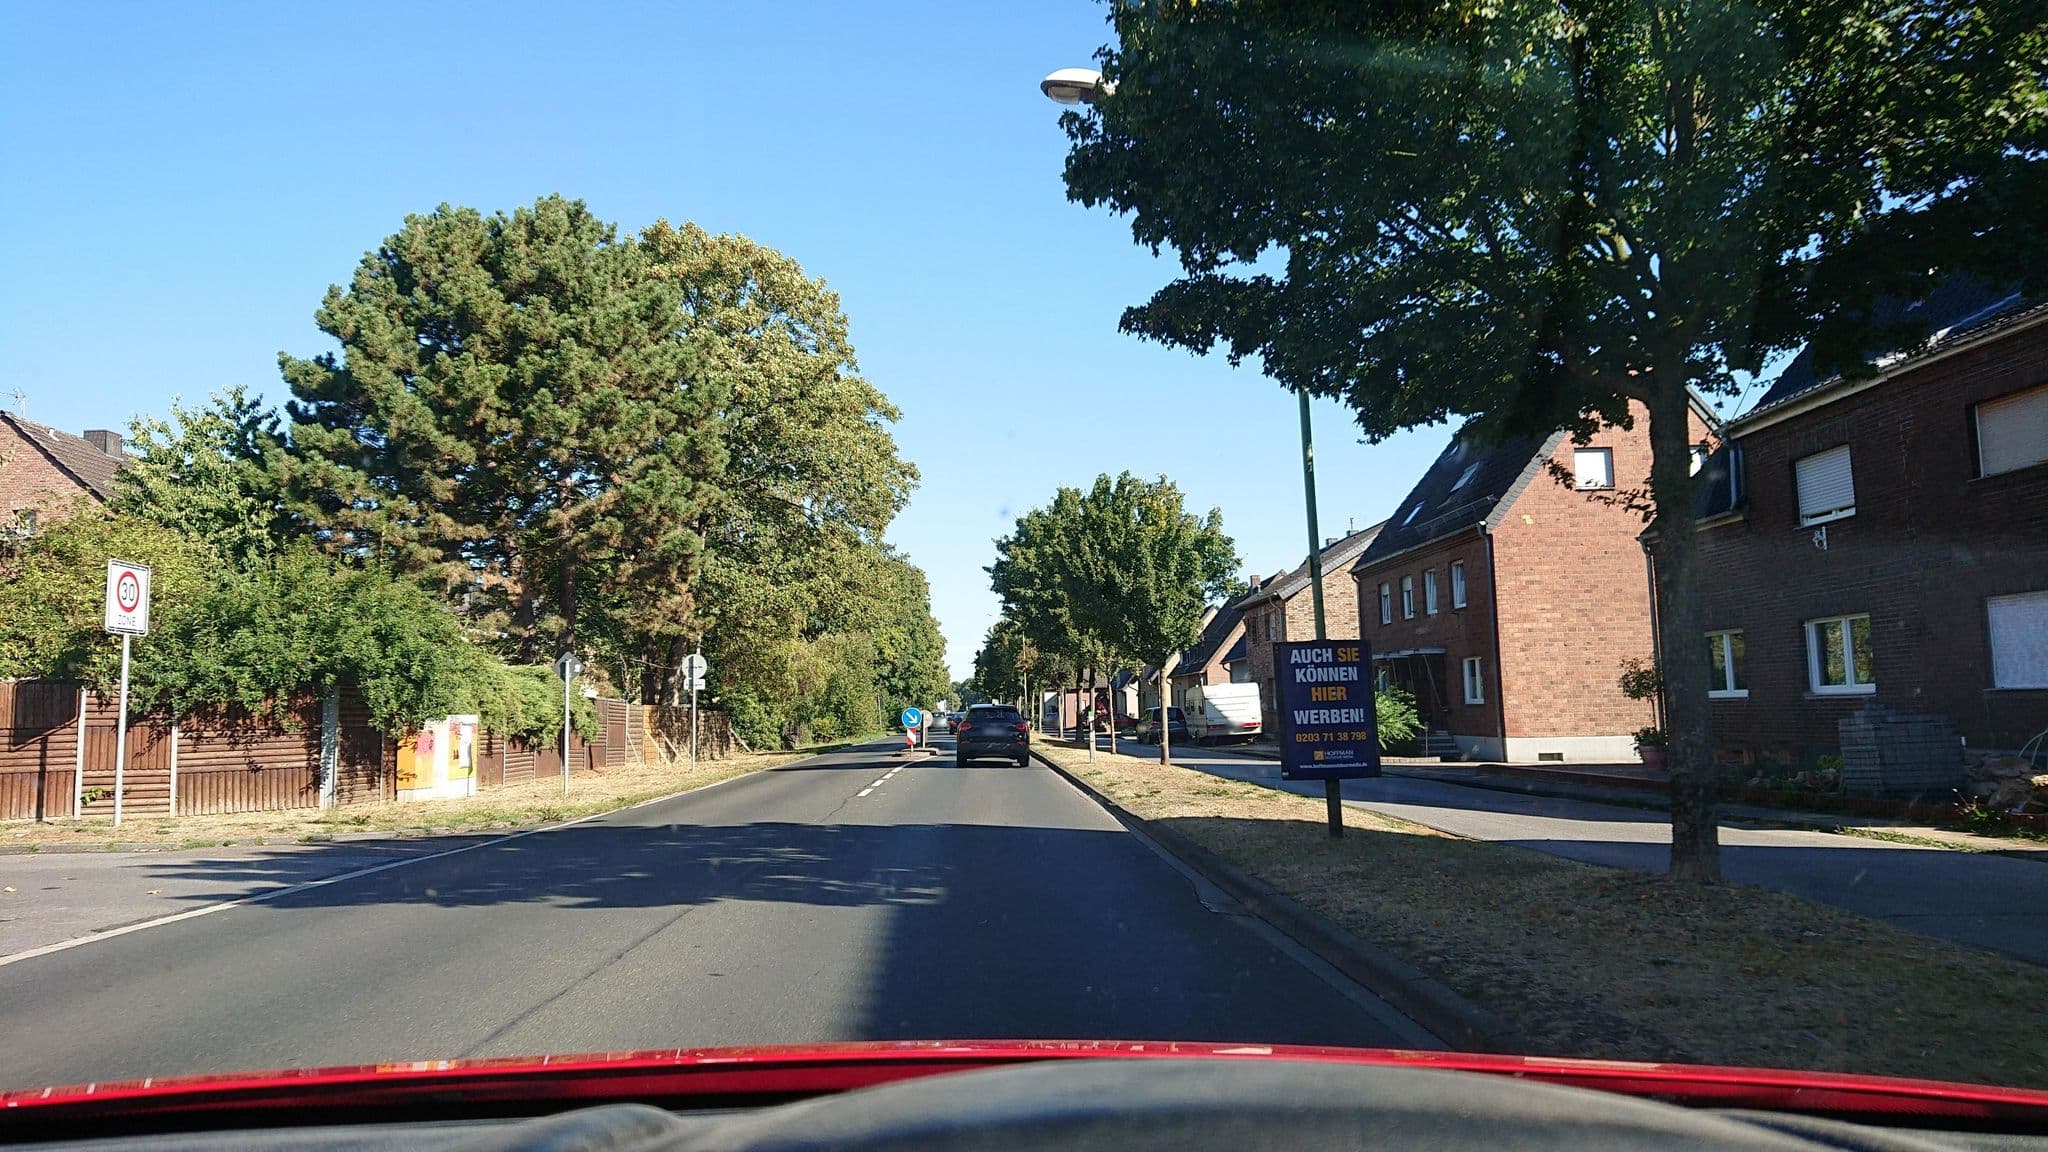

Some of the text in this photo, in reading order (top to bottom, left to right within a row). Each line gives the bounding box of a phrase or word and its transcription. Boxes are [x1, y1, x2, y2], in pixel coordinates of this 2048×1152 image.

[121, 582, 136, 602] 30
[118, 614, 136, 626] ZONE
[1290, 647, 1360, 664] AUCH SIE
[1295, 665, 1358, 683] KÖNNEN
[1311, 686, 1347, 701] HIER
[1293, 708, 1365, 725] WERBEN!
[1295, 732, 1320, 742] 0203
[1323, 732, 1334, 742] 71
